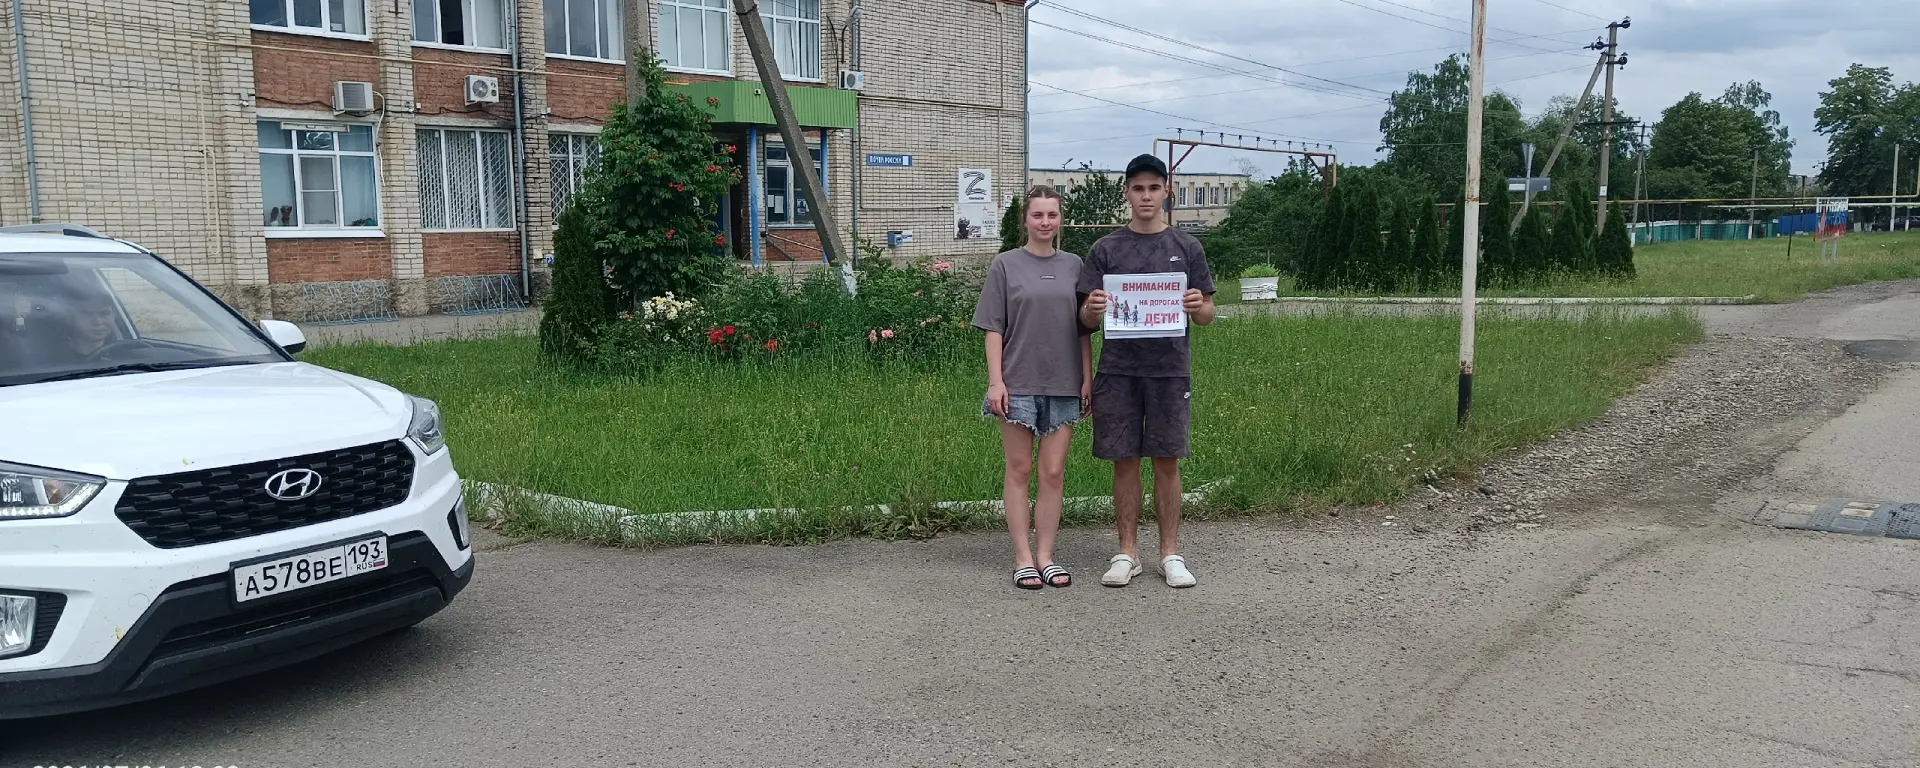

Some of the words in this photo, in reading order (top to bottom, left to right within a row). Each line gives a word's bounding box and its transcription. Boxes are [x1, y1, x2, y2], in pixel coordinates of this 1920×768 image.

[963, 171, 986, 196] Z
[1122, 282, 1180, 292] ВНИМАНИЕ!
[1144, 313, 1180, 326] ДЕТИ!
[245, 556, 342, 597] А578ВЕ
[347, 540, 380, 564] 193
[356, 561, 373, 572] RUS
